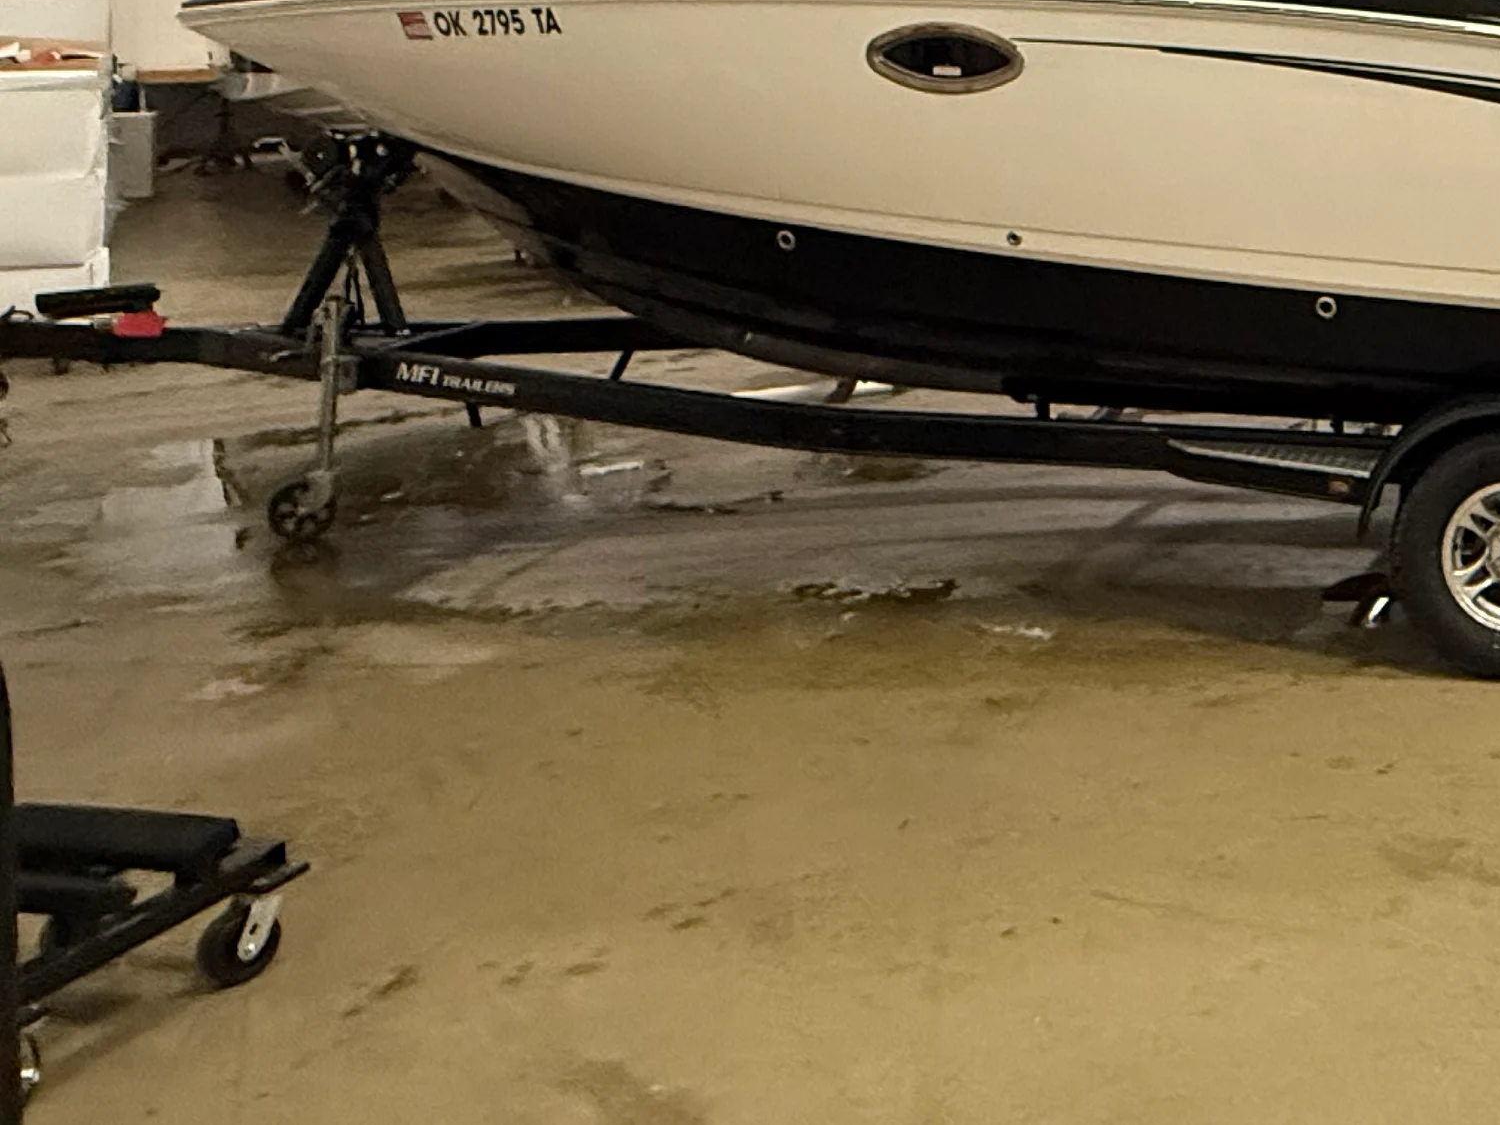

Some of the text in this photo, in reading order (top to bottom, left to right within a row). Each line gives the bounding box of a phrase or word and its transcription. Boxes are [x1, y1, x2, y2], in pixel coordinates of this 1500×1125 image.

[433, 7, 562, 36] OK 2795 TA
[396, 361, 440, 386] MFI
